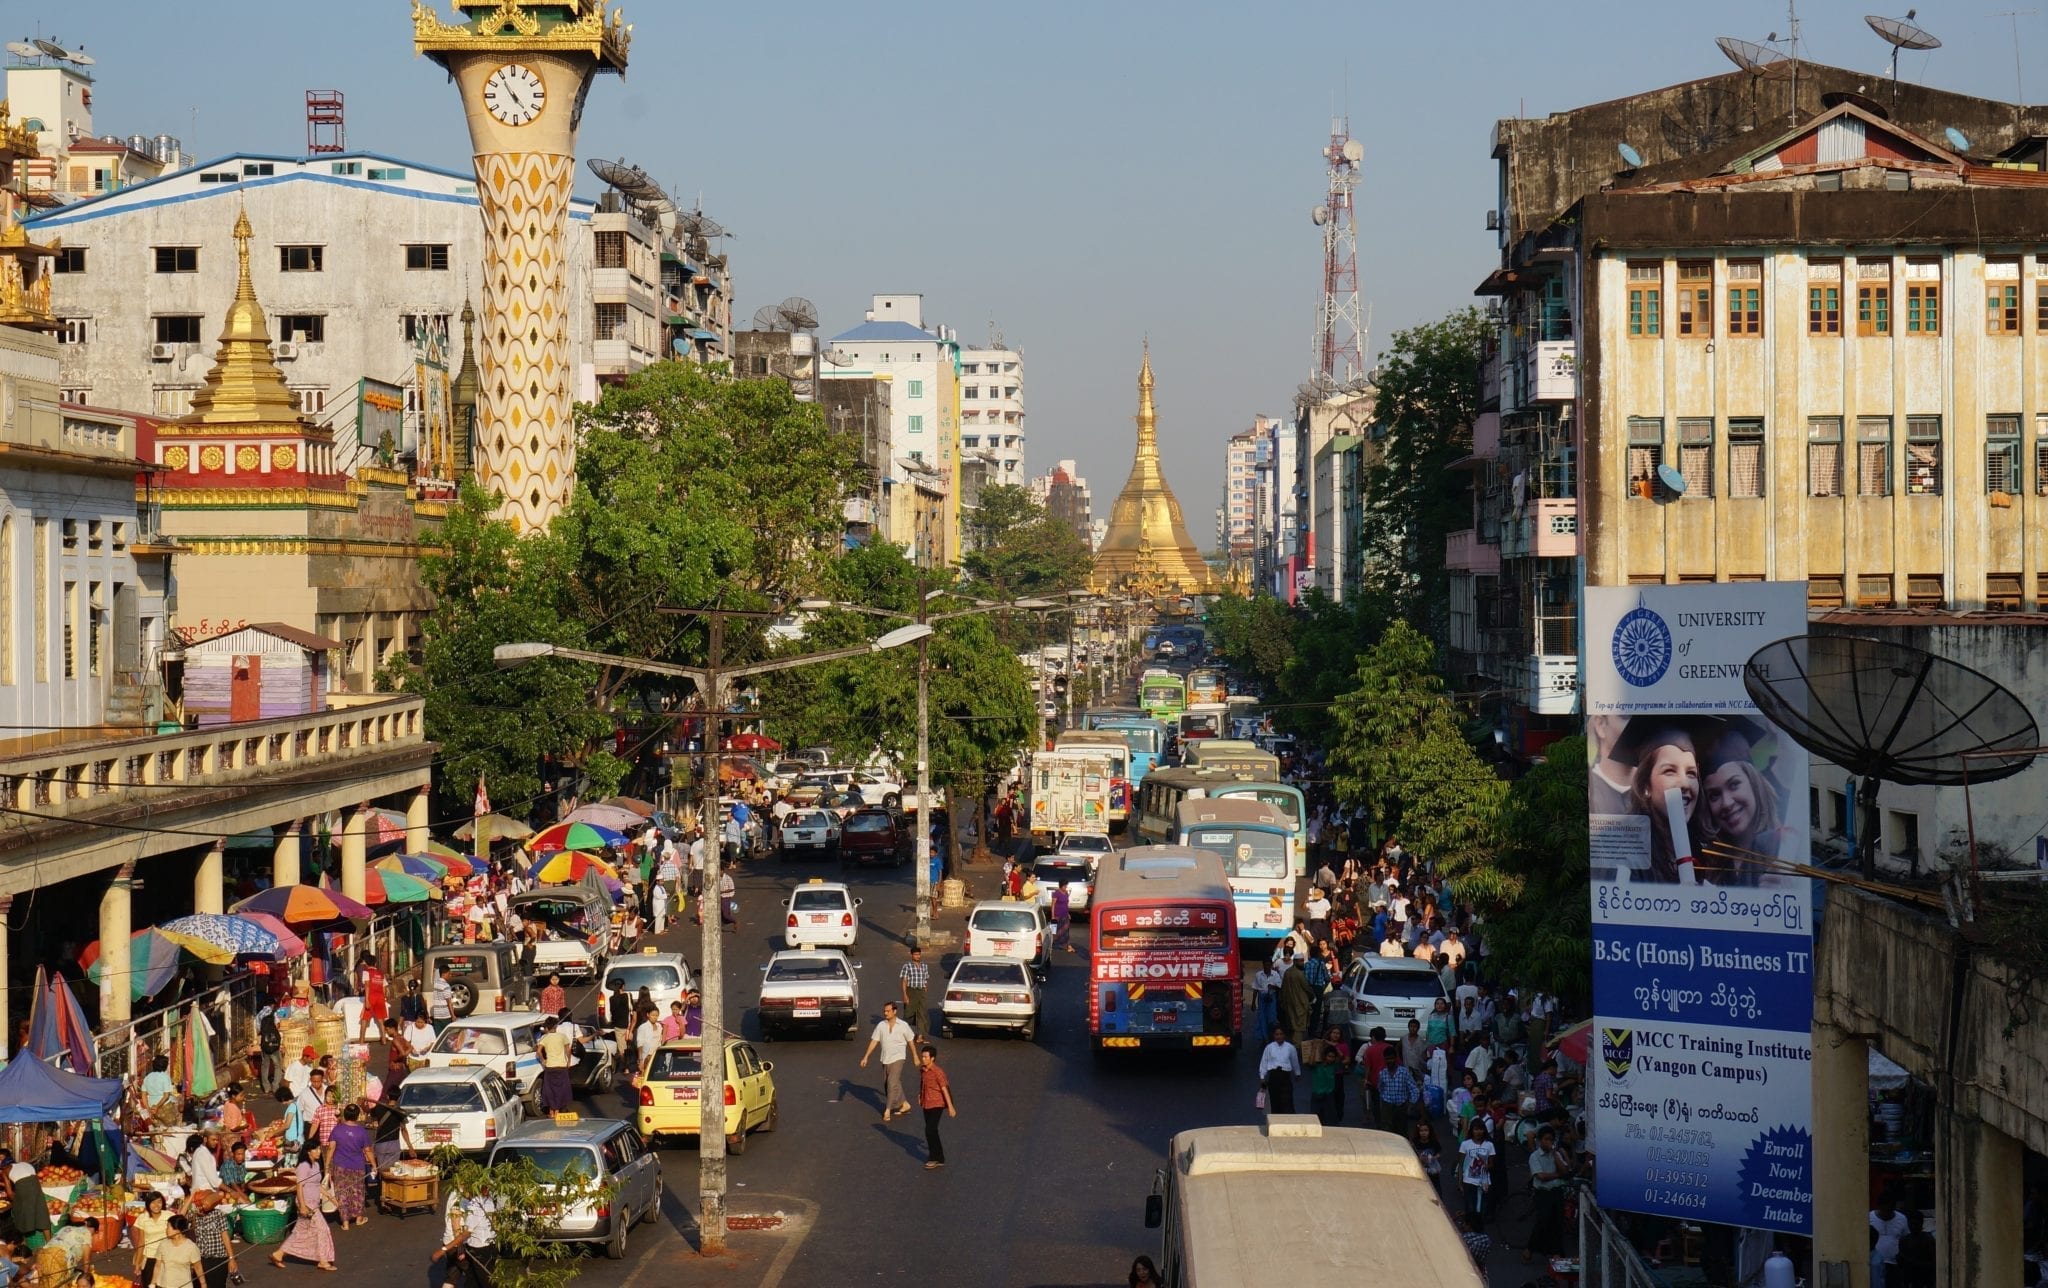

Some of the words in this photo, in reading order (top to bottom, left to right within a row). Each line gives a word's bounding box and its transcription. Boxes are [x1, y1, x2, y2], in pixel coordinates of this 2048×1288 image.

[1678, 611, 1766, 627] UNIVERSITY
[1678, 638, 1694, 656] of
[1678, 664, 1771, 679] GREENWCH
[1595, 701, 1615, 711] Top-up
[1616, 701, 1634, 711] degree
[1634, 702, 1668, 710] programme
[1667, 701, 1675, 709] in
[1675, 700, 1714, 709] collaboration
[1714, 700, 1727, 709] with
[1728, 700, 1743, 709] NCC
[1598, 885, 1680, 919] နိုင်ငံတကာ
[1690, 890, 1803, 930] အသိအမှတ်ပြု
[1594, 939, 1631, 962] B.Sc
[1636, 941, 1694, 972] (Hons)
[1699, 945, 1781, 973] Business
[1786, 951, 1809, 974] IT
[1097, 963, 1201, 979] FERROVIT
[1633, 977, 1702, 1013] ကွန်ပျူတာ
[1636, 1031, 1674, 1049] MCC
[1679, 1034, 1743, 1058] Training
[1748, 1039, 1812, 1061] Institute
[1636, 1055, 1697, 1078] (Yangon
[1701, 1061, 1768, 1086] Campus)
[1698, 1103, 1760, 1124] တတိယထပ်
[1625, 1124, 1645, 1140] Ph:
[1649, 1126, 1715, 1149] 01-245762,
[1647, 1147, 1711, 1168] 01-249152
[1763, 1140, 1805, 1159] Enroll
[1646, 1167, 1709, 1188] 01-395512
[1768, 1162, 1803, 1181] Now!
[1645, 1188, 1707, 1209] 01-246634
[1751, 1182, 1813, 1203] December
[1762, 1205, 1803, 1224] Intake
